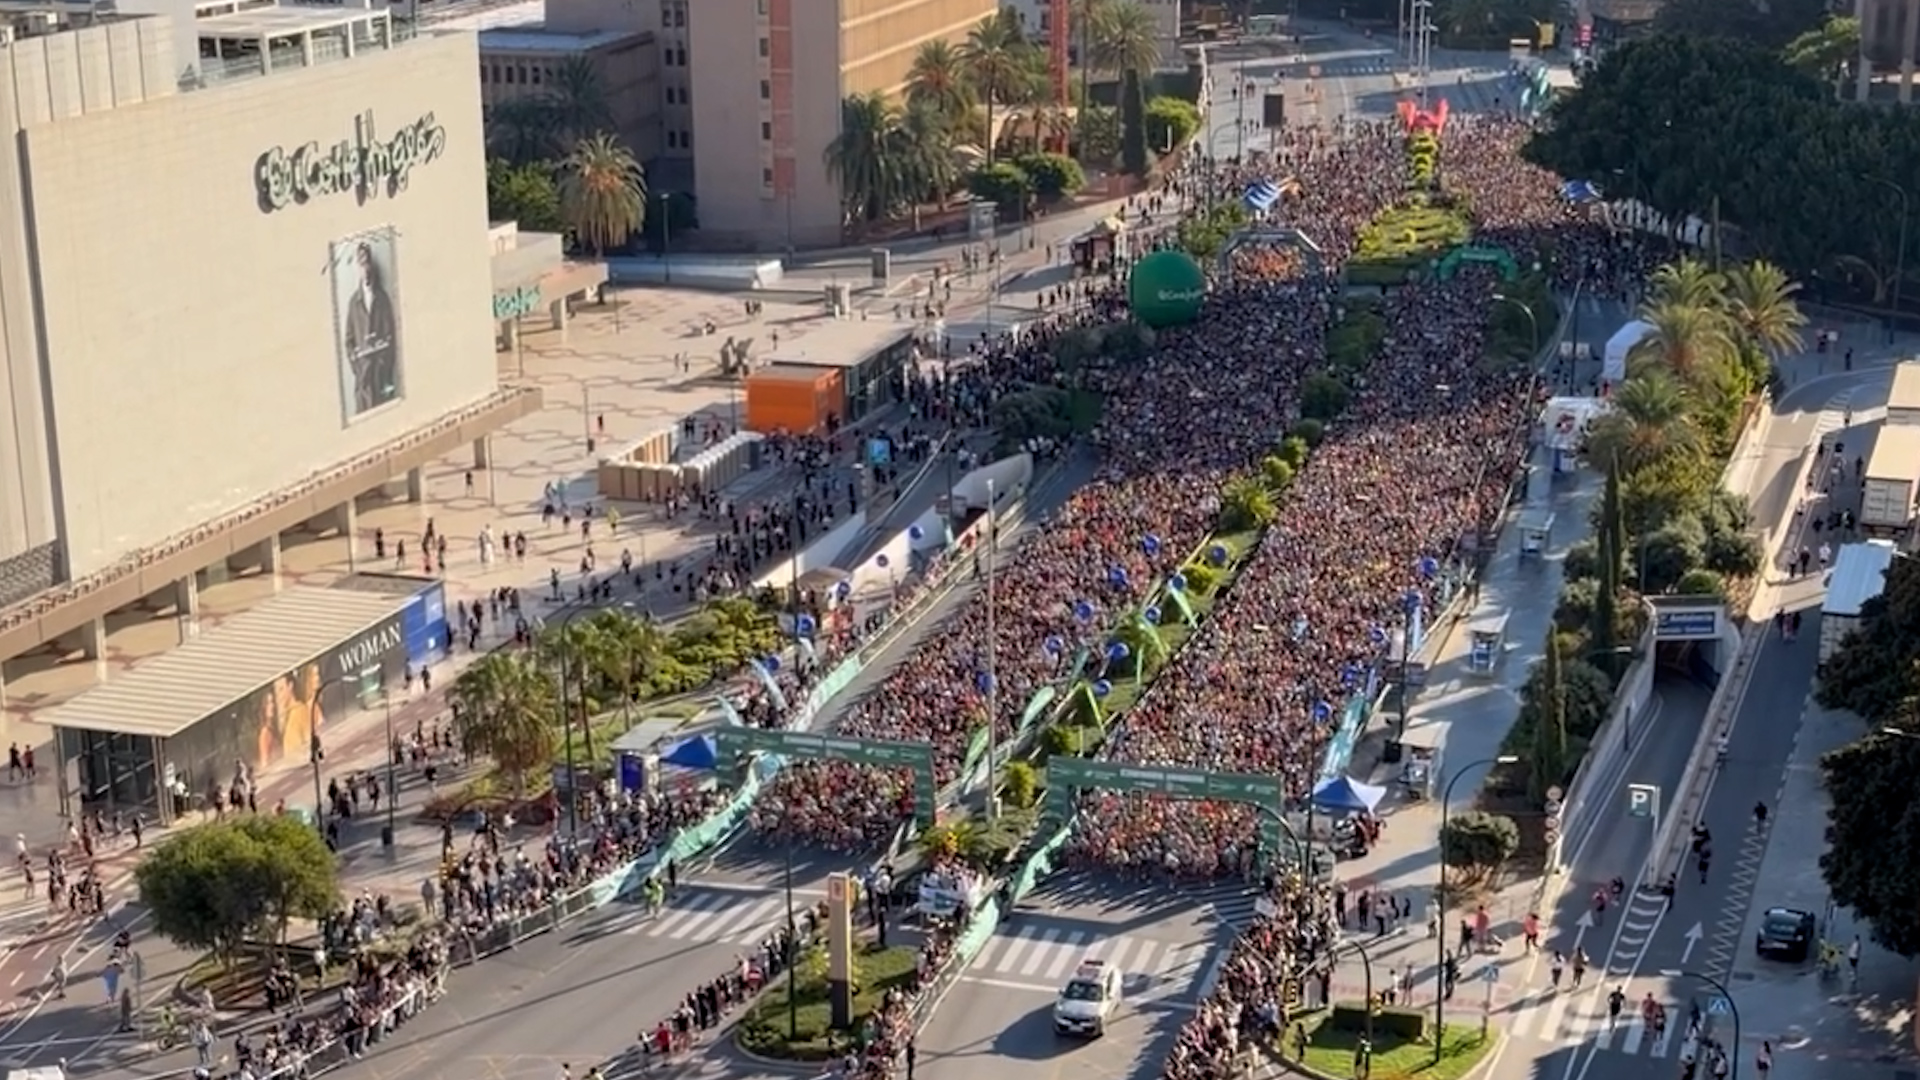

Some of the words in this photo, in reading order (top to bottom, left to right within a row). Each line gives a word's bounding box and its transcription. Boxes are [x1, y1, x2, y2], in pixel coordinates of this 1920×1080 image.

[303, 138, 359, 195] Corte
[364, 108, 446, 199] Inglés
[339, 621, 401, 673] WOMAN
[1631, 791, 1648, 809] P
